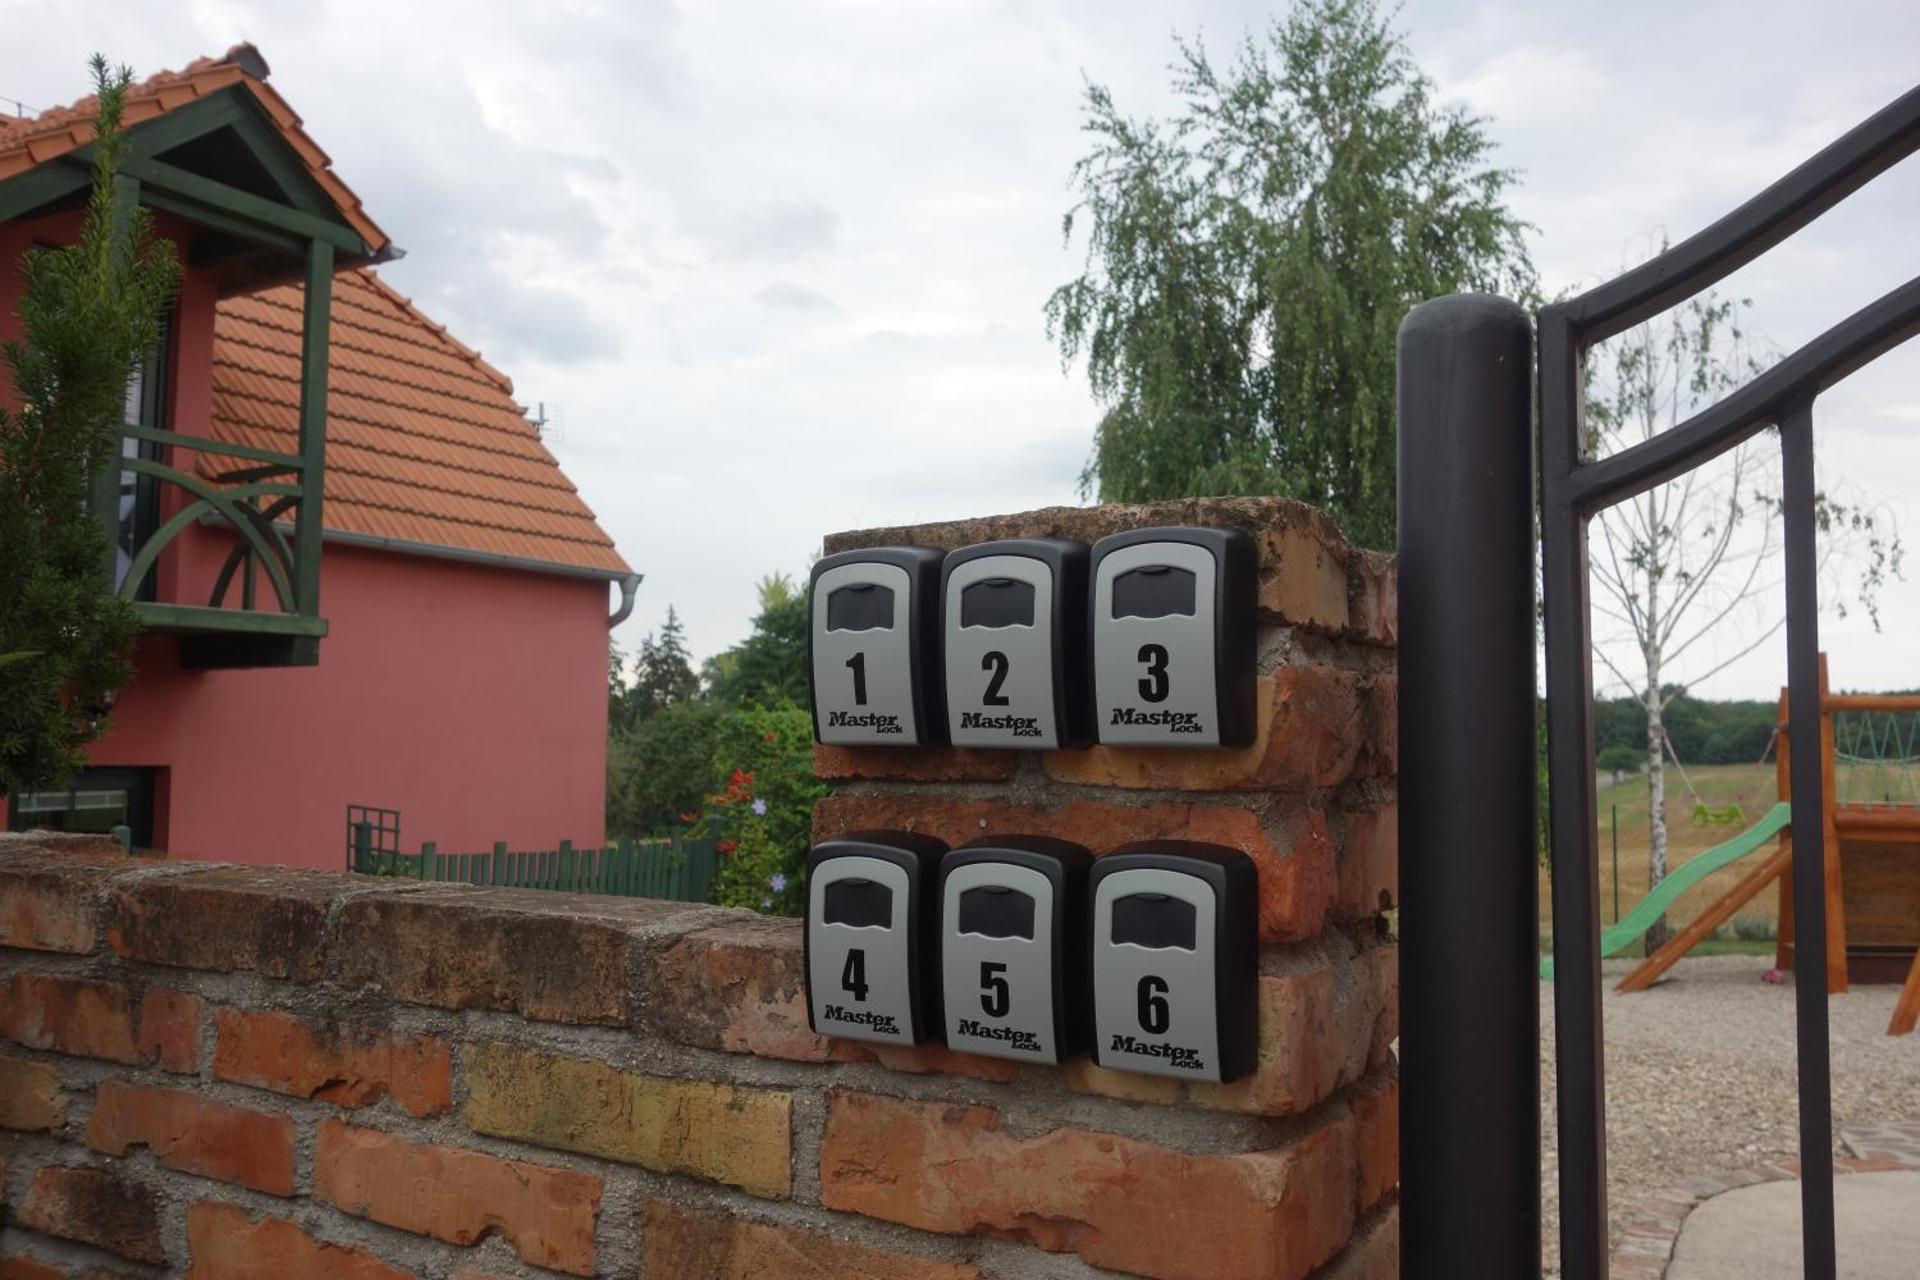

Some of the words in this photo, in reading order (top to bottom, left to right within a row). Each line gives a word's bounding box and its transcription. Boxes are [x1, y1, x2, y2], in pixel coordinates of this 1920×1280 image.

[845, 652, 868, 706] 1
[981, 651, 1009, 706] 2
[1137, 643, 1169, 703] 3
[828, 711, 898, 728] Master
[960, 712, 1037, 729] Master
[1110, 708, 1198, 726] Master
[1170, 720, 1203, 734] Lock
[876, 723, 903, 734] Lock
[1013, 724, 1042, 737] Lock
[841, 948, 869, 1001] 4
[980, 961, 1010, 1018] 5
[824, 1004, 895, 1026] Master
[1137, 975, 1170, 1035] 6
[872, 1021, 900, 1035] Lock
[958, 1019, 1036, 1043] Master
[1011, 1038, 1042, 1052] Lock
[1110, 1034, 1198, 1060] Master
[1170, 1055, 1204, 1070] Lock
